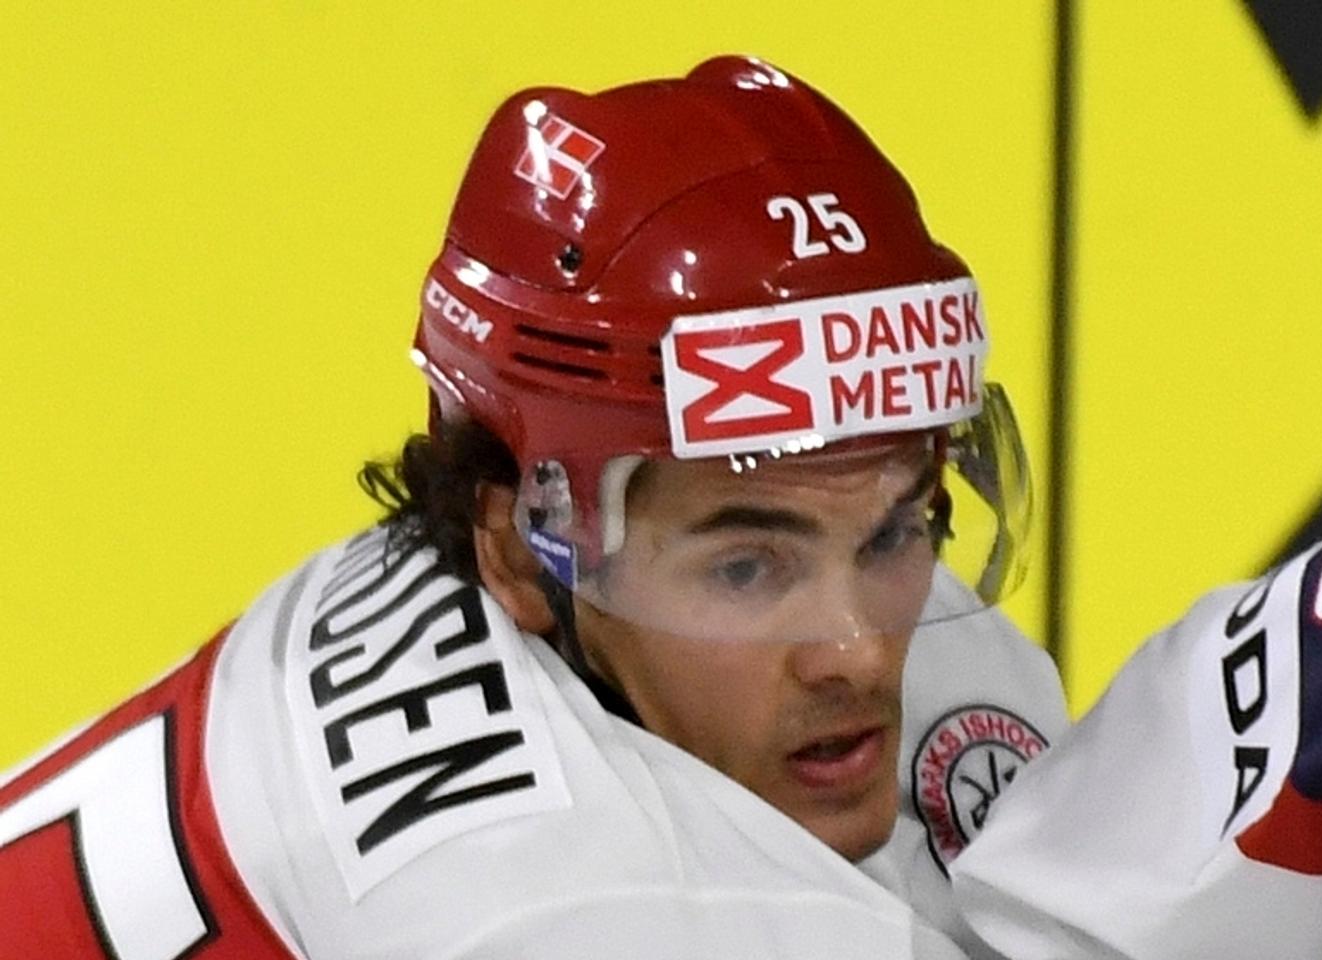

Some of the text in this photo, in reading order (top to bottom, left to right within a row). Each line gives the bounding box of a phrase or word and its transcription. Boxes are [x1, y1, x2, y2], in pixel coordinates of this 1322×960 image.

[767, 193, 867, 259] 25
[426, 278, 494, 343] CCM
[821, 291, 984, 364] DANSK
[830, 355, 979, 425] METAL
